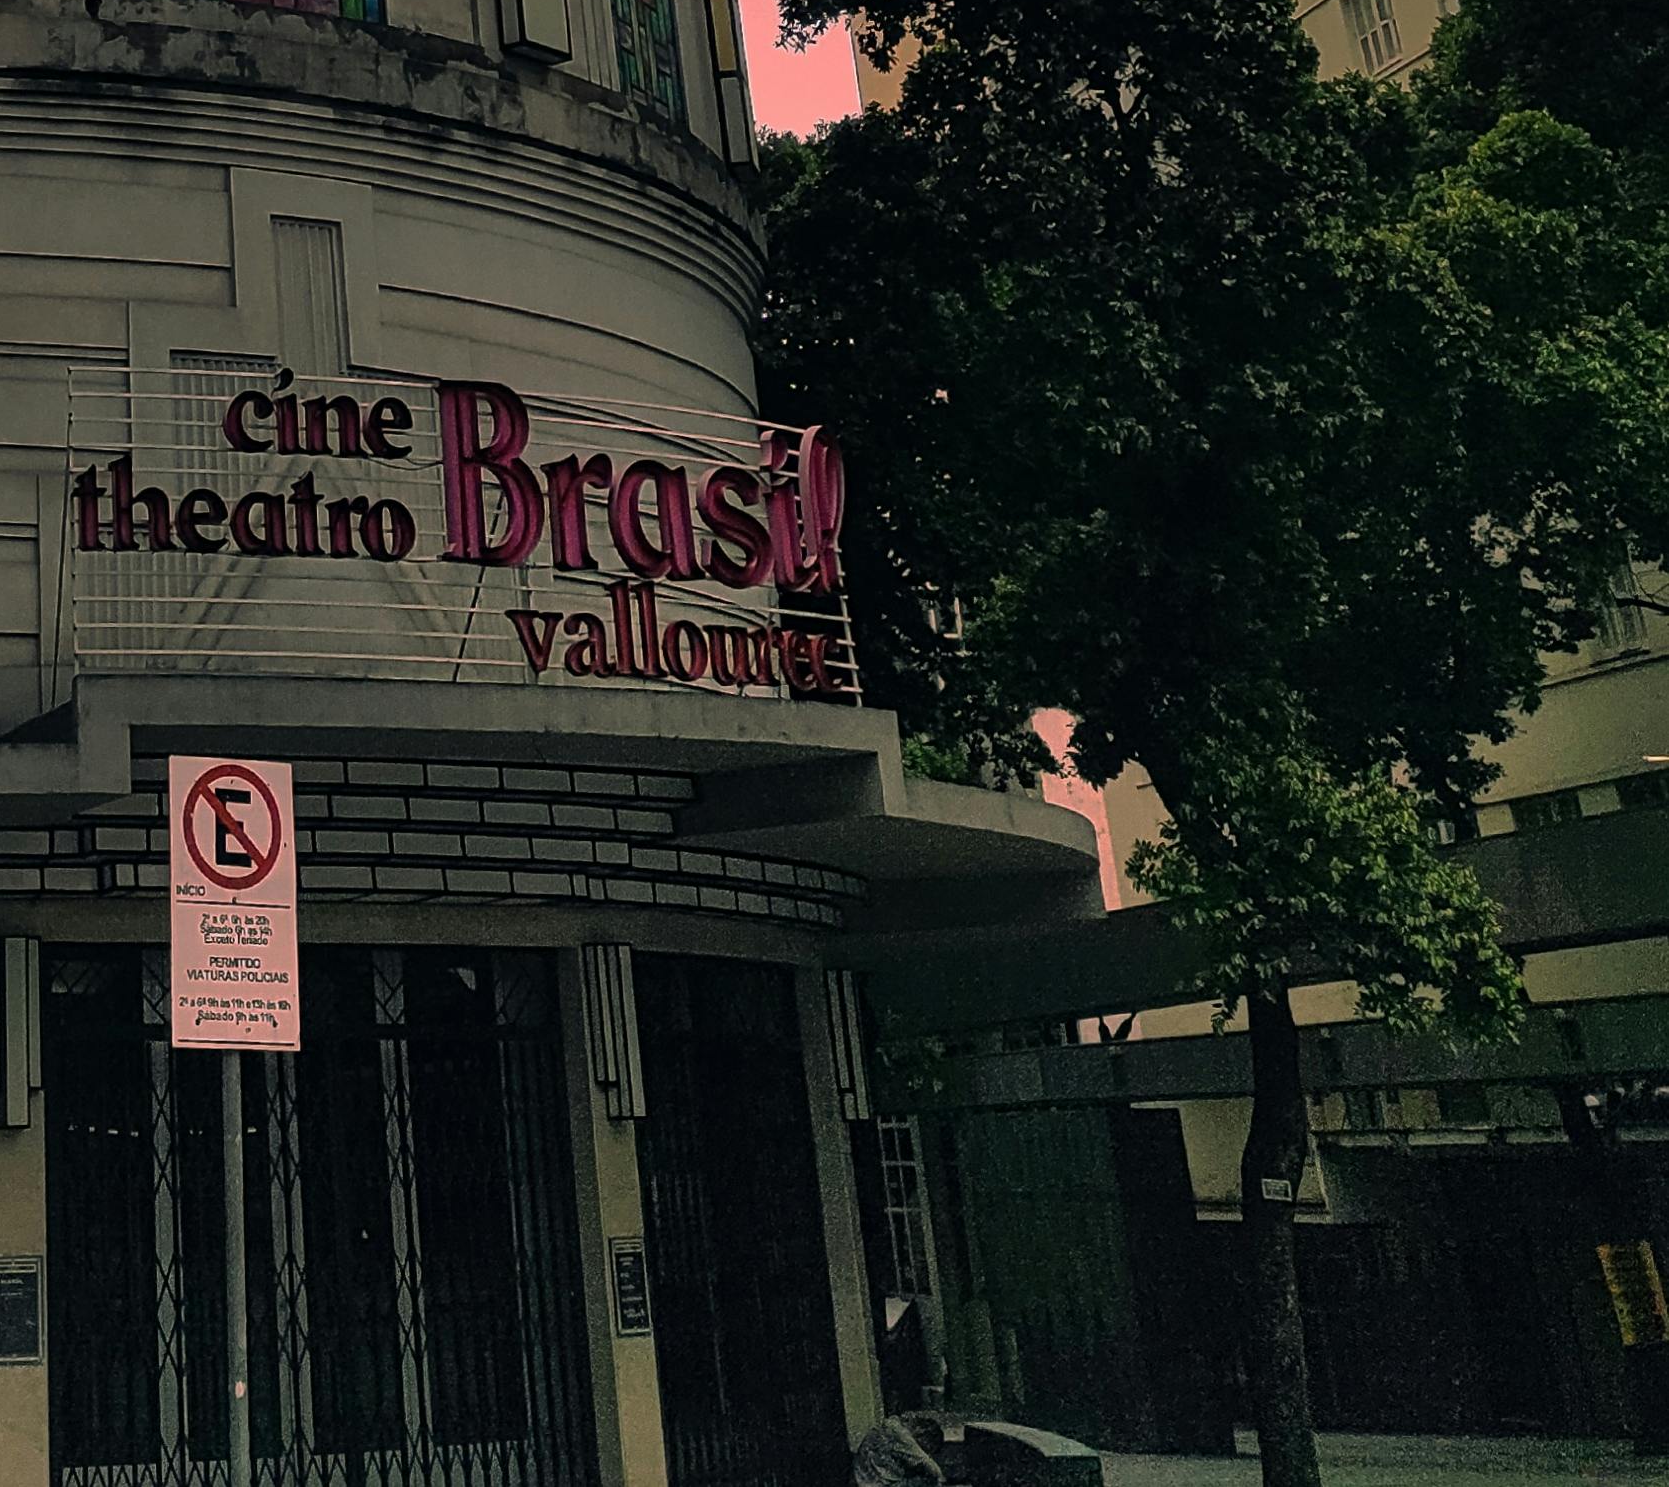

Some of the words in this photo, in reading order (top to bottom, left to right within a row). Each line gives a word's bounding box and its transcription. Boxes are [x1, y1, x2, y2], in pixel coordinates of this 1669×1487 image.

[222, 367, 414, 458] cine
[71, 454, 417, 562] theatro
[437, 378, 847, 594] Brasil
[504, 577, 845, 693] vallourec
[214, 787, 253, 869] E
[186, 969, 239, 982] VIATURAS
[241, 971, 289, 983] POLICIAIS
[209, 956, 261, 969] PERMITIDO
[198, 1010, 234, 1021] Sábado
